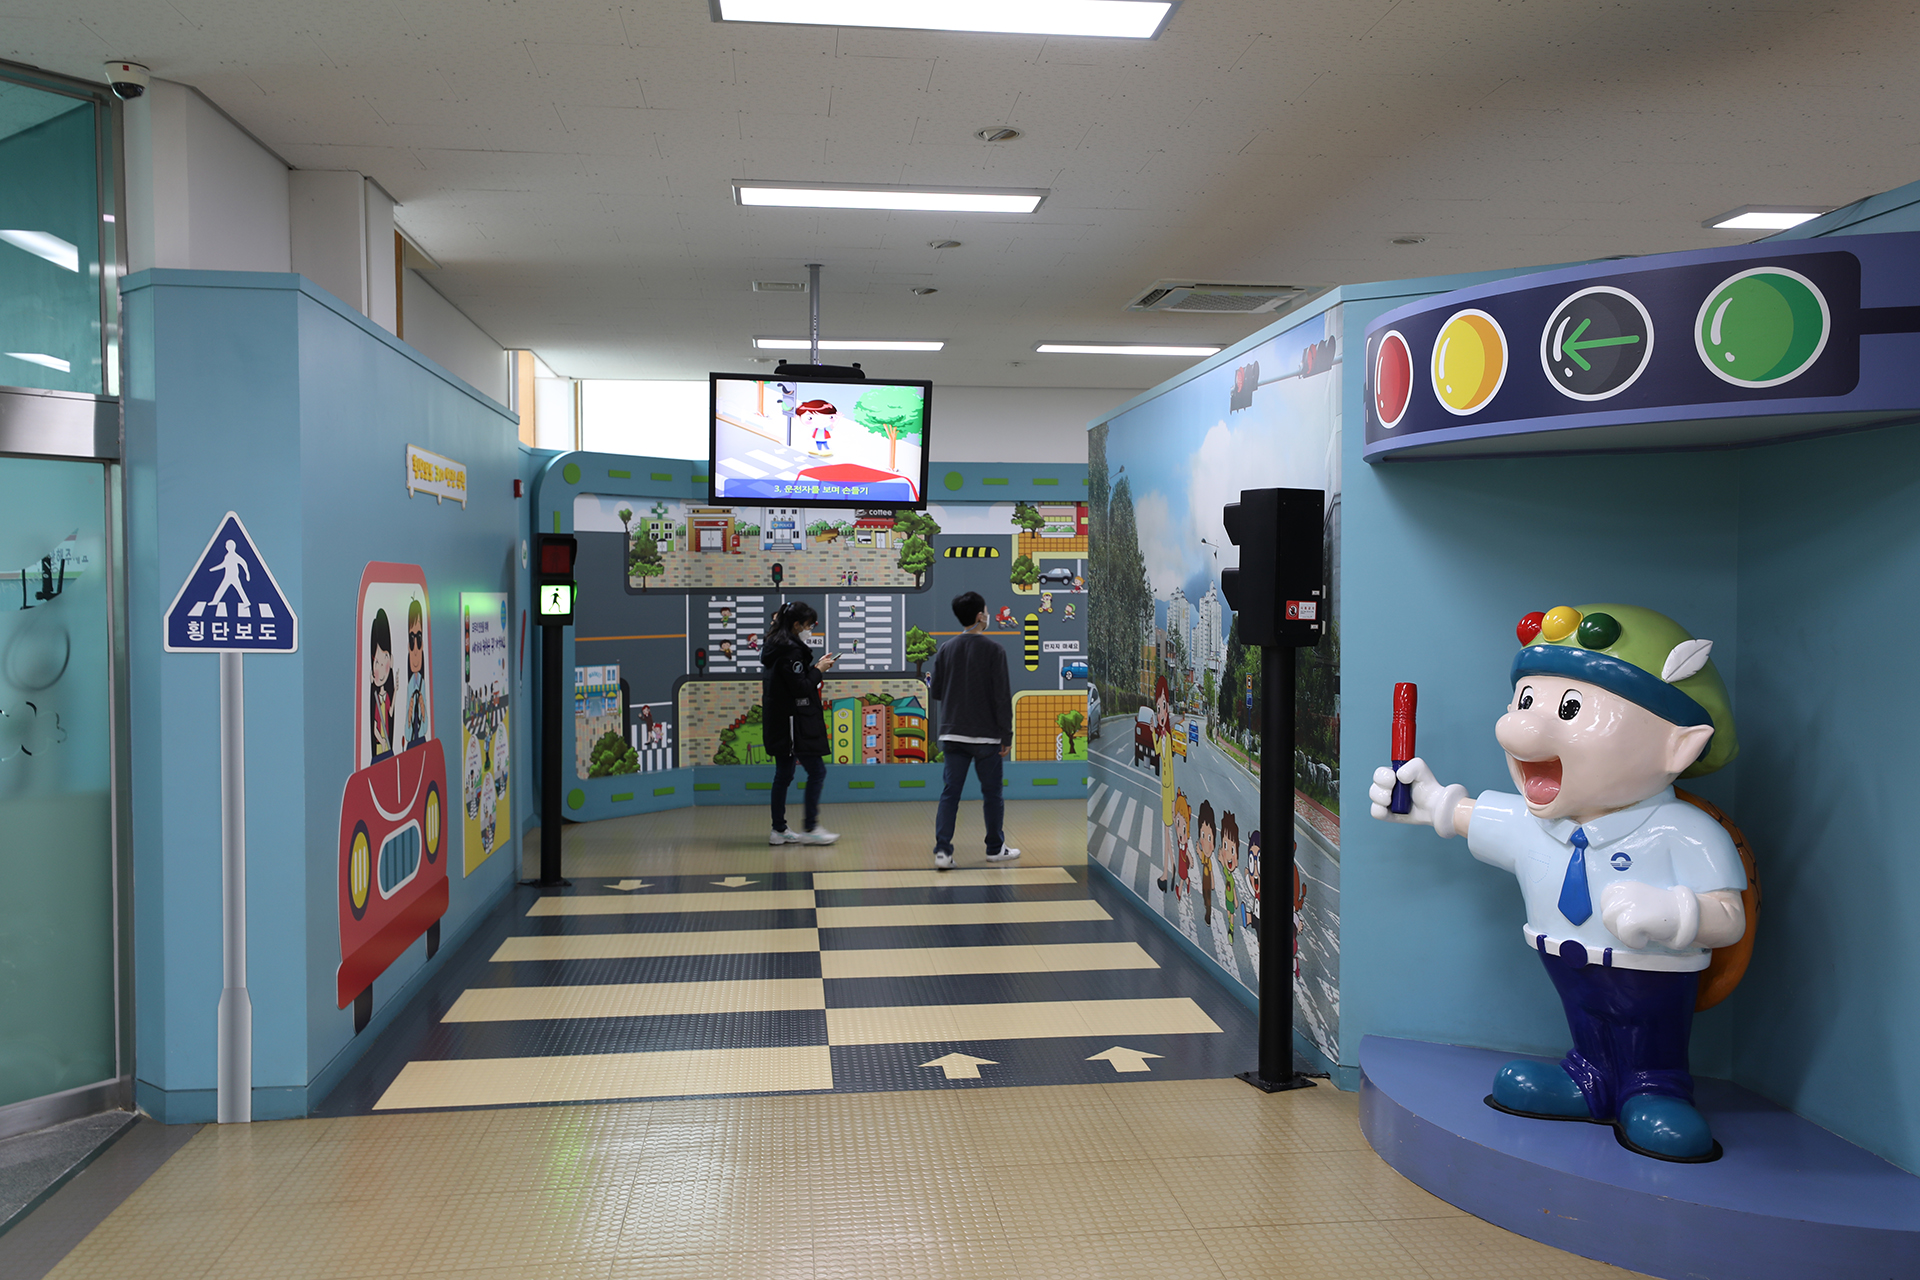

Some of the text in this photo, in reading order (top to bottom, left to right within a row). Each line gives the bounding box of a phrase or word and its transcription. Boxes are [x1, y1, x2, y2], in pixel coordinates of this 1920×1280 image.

[774, 484, 869, 495] 3. 운전자를 보며 손들기
[187, 621, 277, 642] 횡단보도
